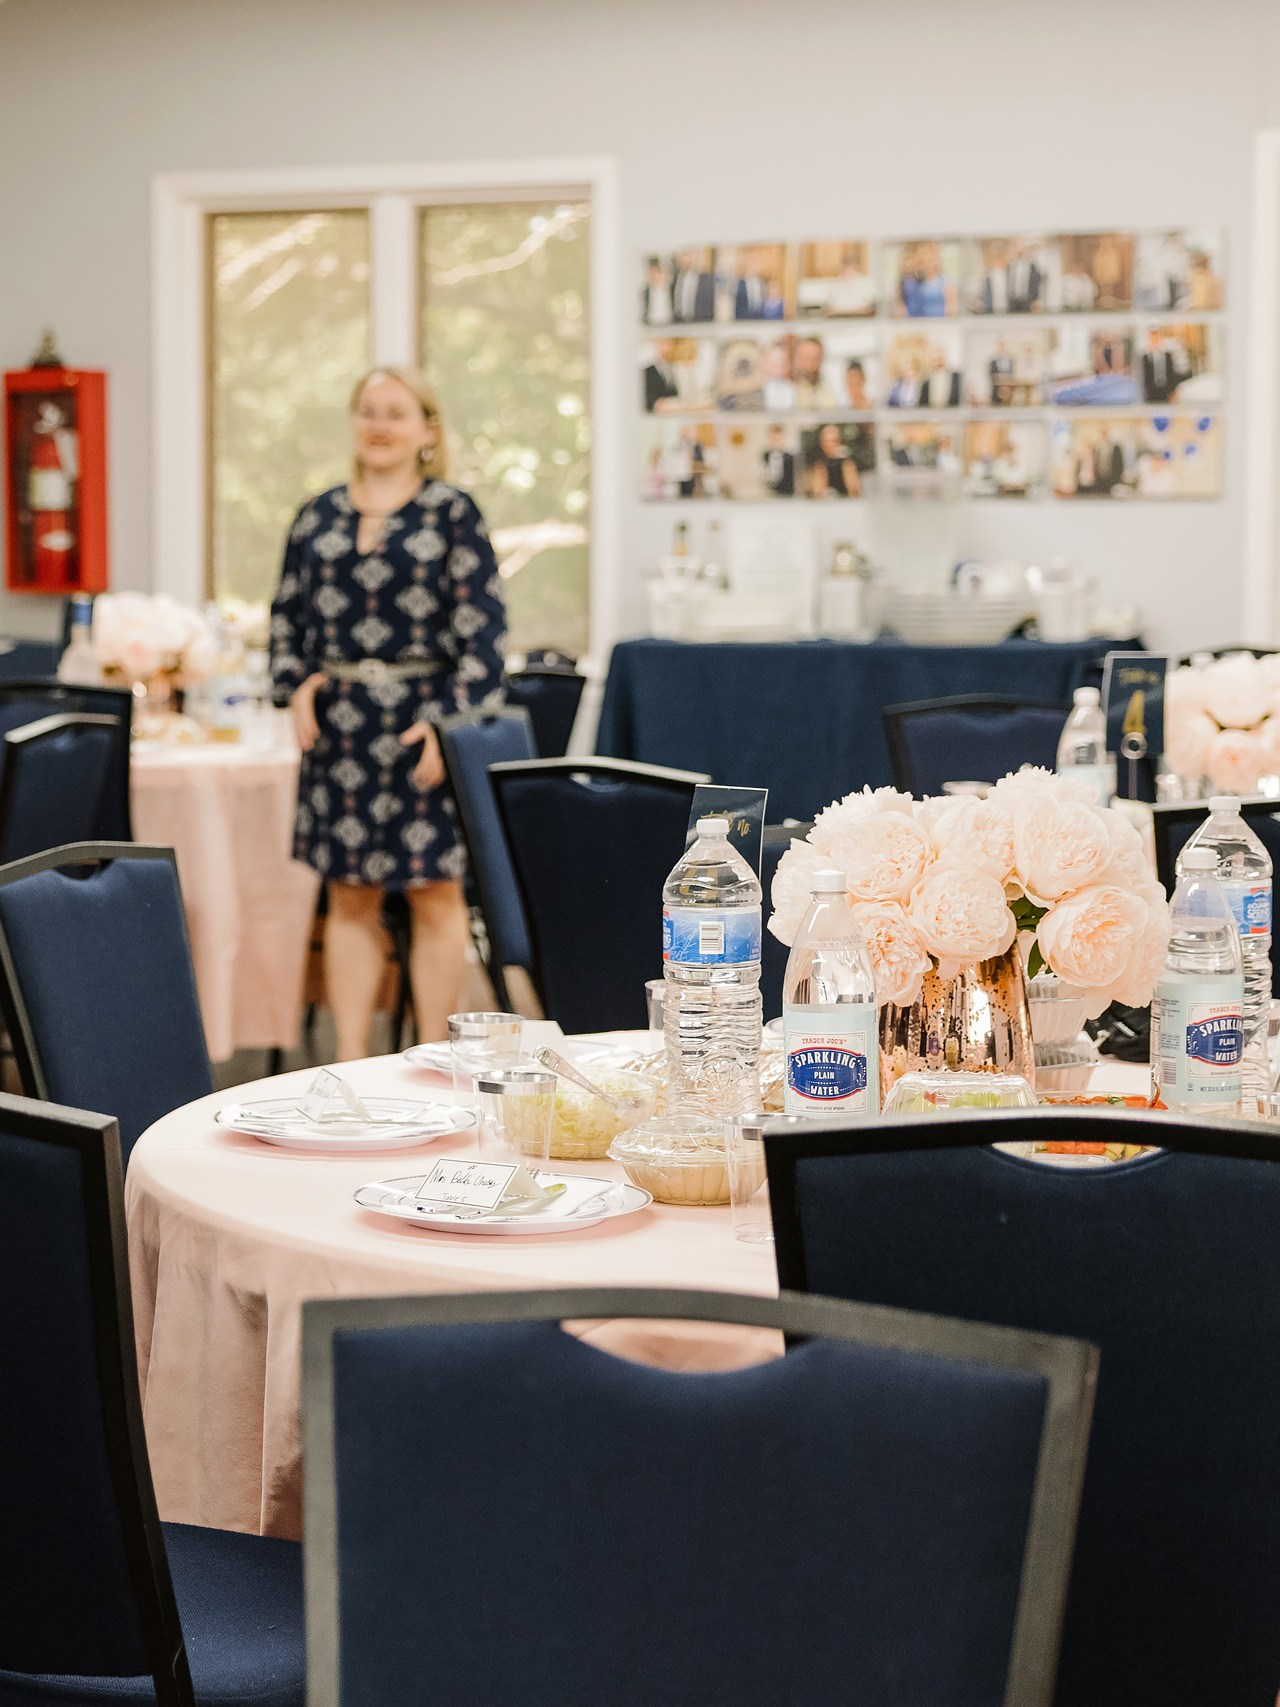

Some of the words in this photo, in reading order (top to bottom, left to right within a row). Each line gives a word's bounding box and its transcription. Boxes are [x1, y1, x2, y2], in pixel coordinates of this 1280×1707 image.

[1218, 1037, 1236, 1046] PLAIN
[794, 1051, 857, 1069] SPARKLING
[1215, 1050, 1238, 1062] WATER
[813, 1071, 835, 1080] PLAIN
[810, 1085, 840, 1096] WATER
